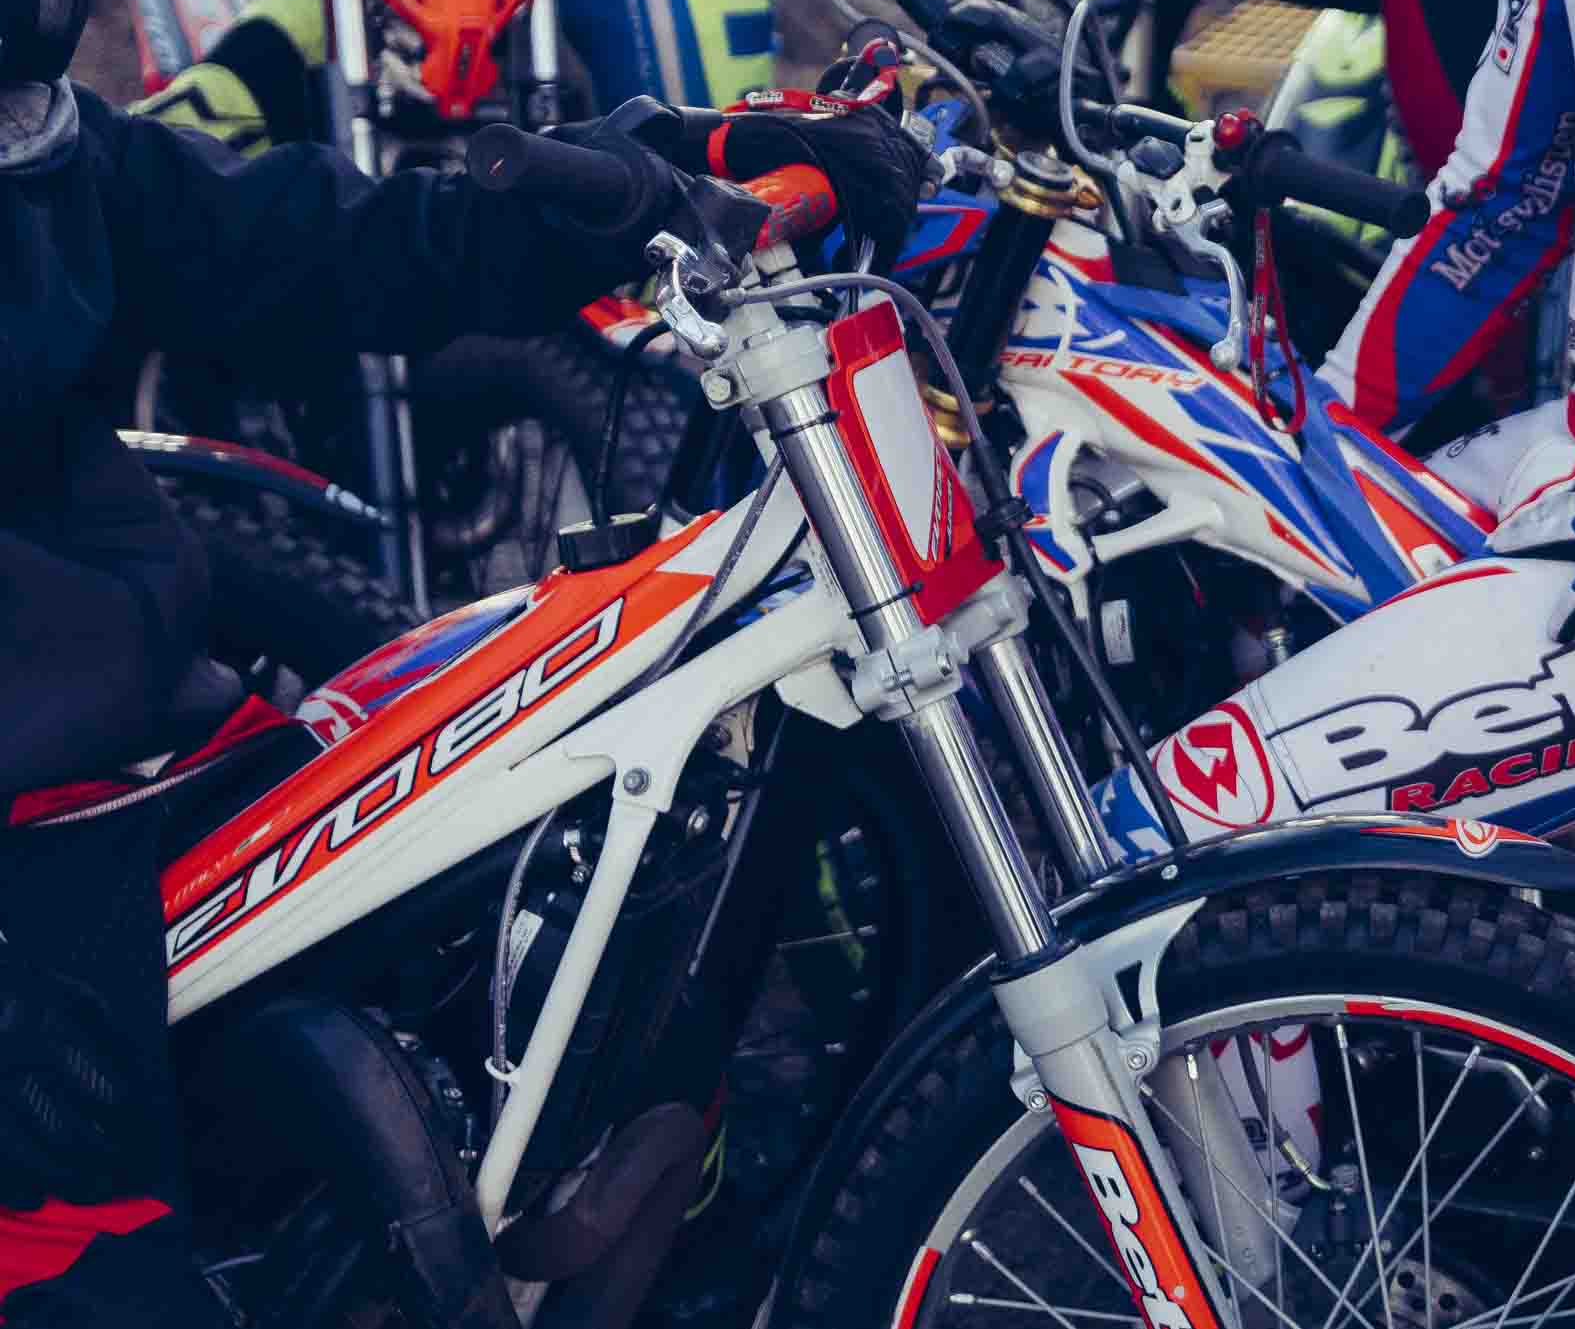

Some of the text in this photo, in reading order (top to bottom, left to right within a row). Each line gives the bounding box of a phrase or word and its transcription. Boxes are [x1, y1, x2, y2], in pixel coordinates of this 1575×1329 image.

[164, 745, 424, 968] EVO
[430, 592, 627, 779] 80
[1070, 1142, 1198, 1329] Bet
